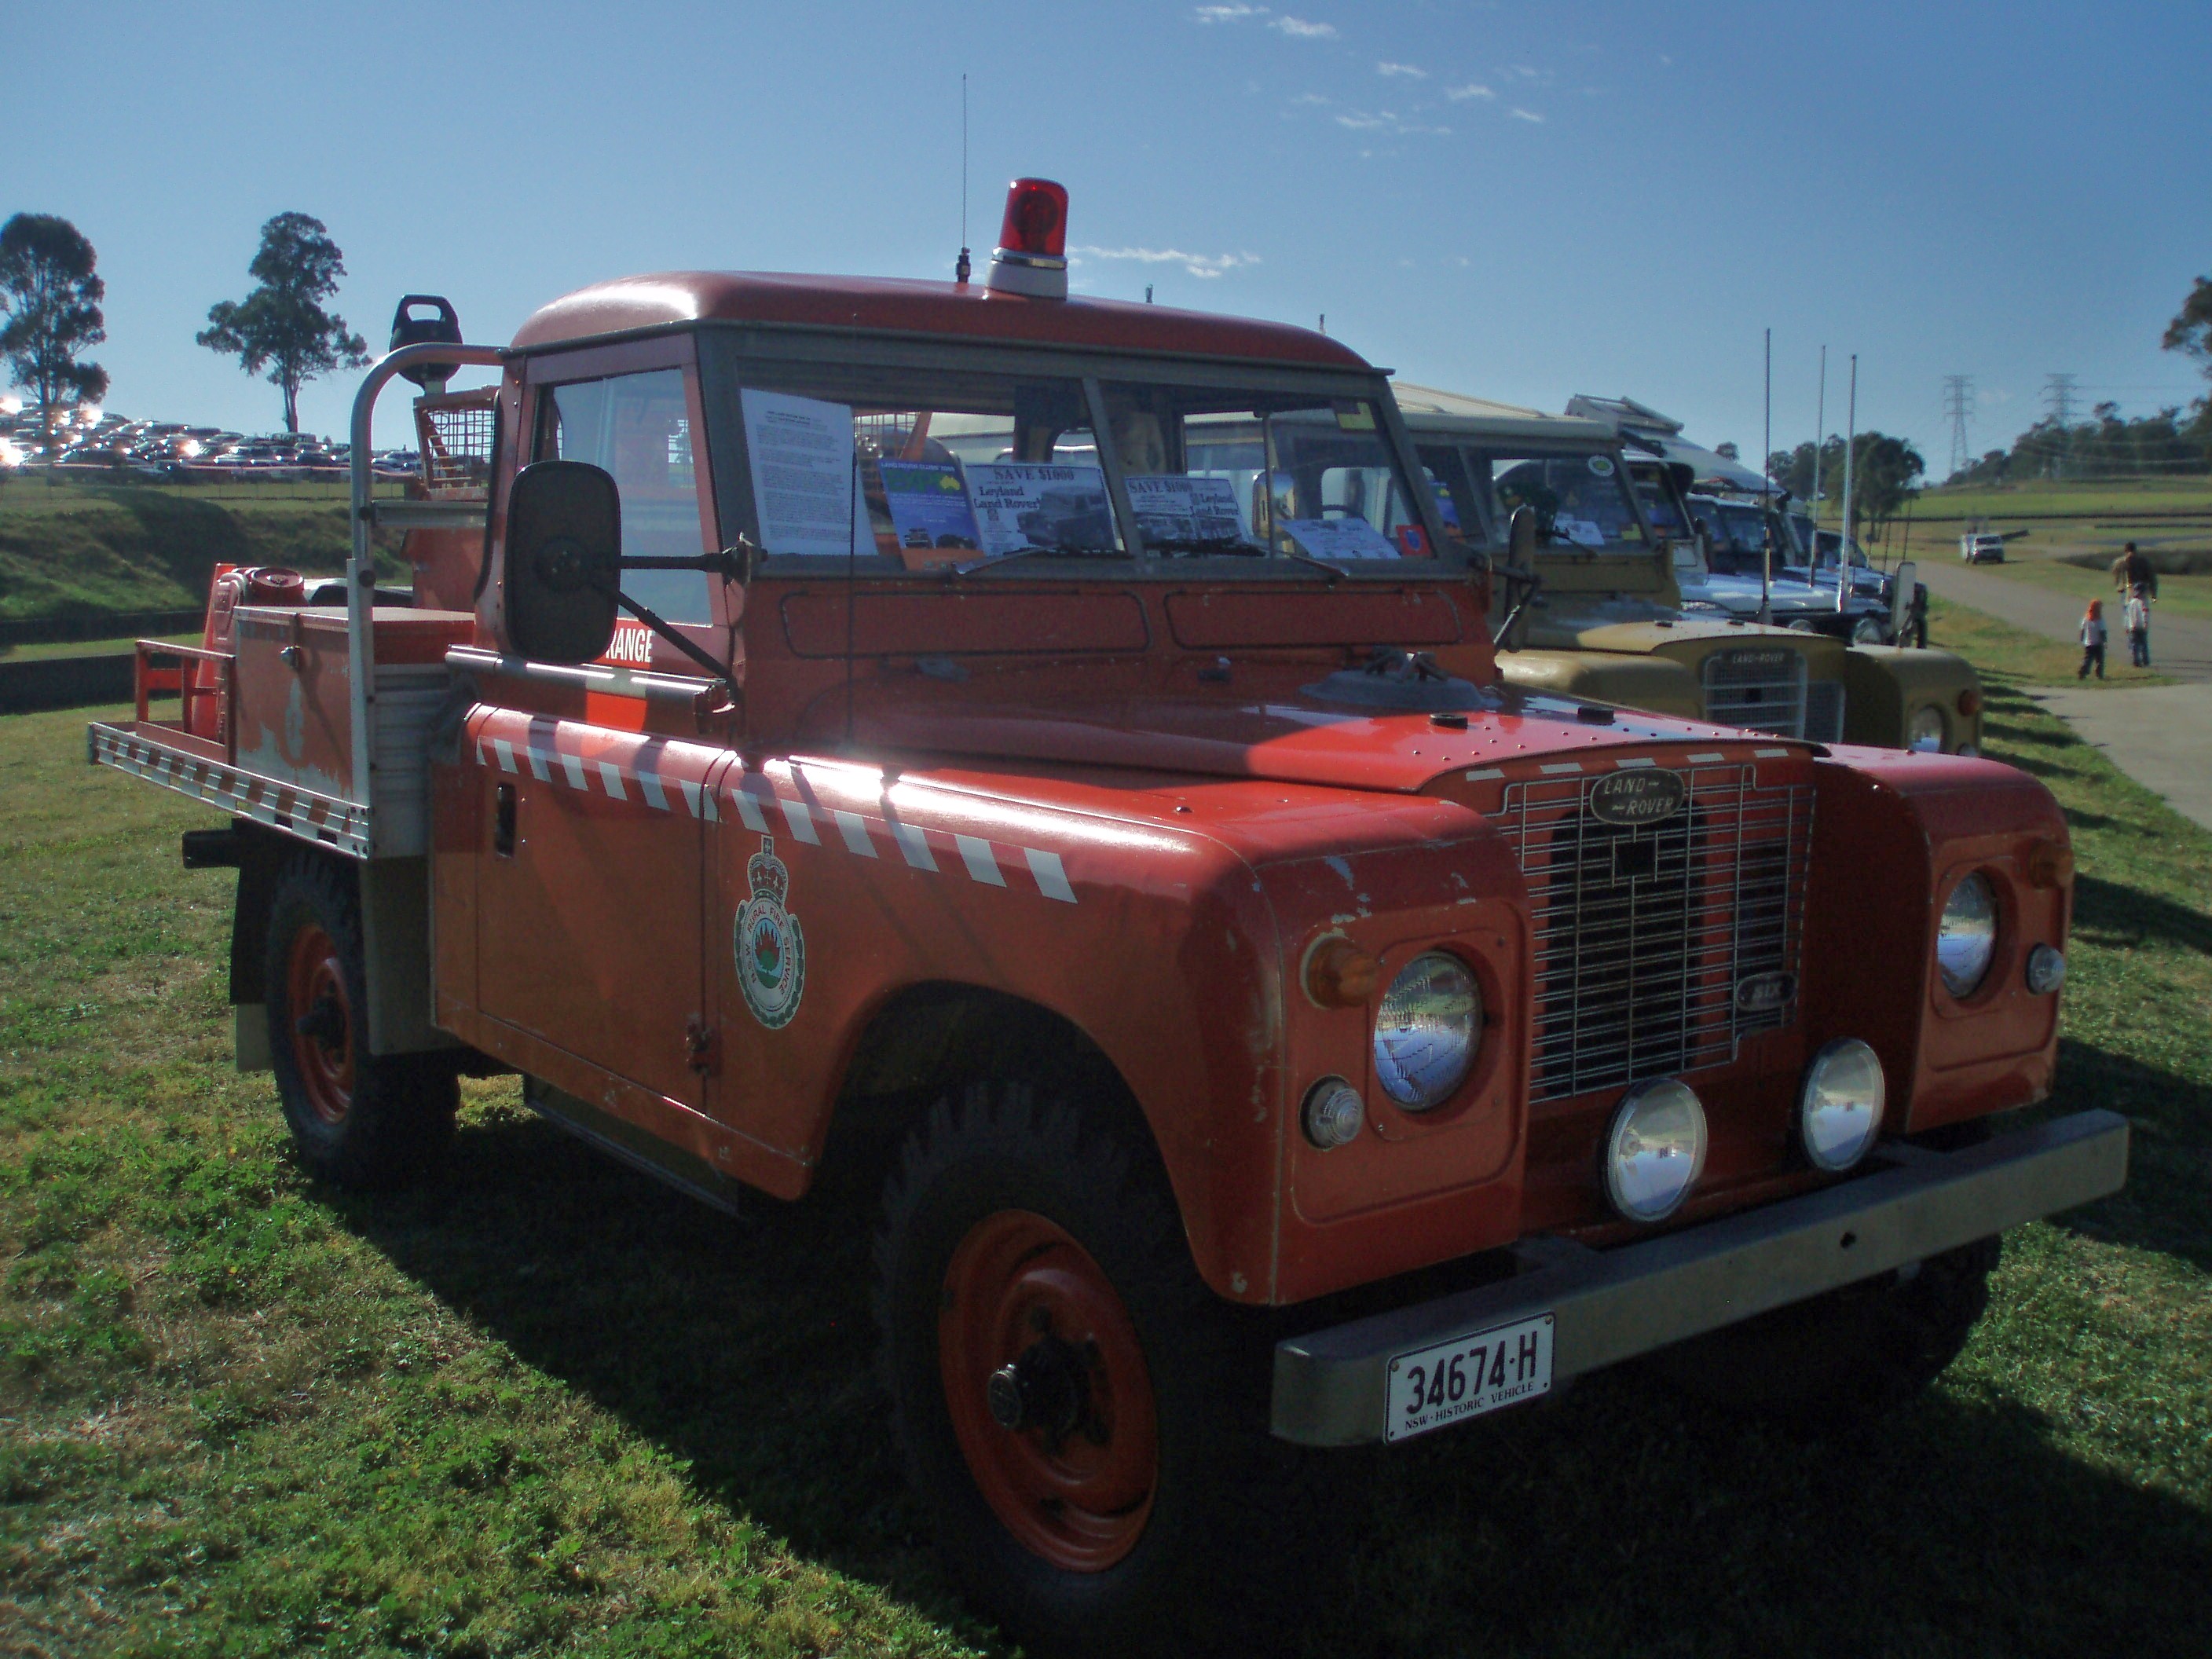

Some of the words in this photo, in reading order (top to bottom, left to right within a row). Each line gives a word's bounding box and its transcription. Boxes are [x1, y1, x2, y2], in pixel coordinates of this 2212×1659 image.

[994, 468, 1035, 481] SAVE
[979, 485, 1024, 498] Leyland
[974, 498, 1002, 508] Land
[747, 906, 767, 933] RURAL
[770, 907, 785, 931] FIRE
[1491, 1381, 1534, 1404] VEHICLE
